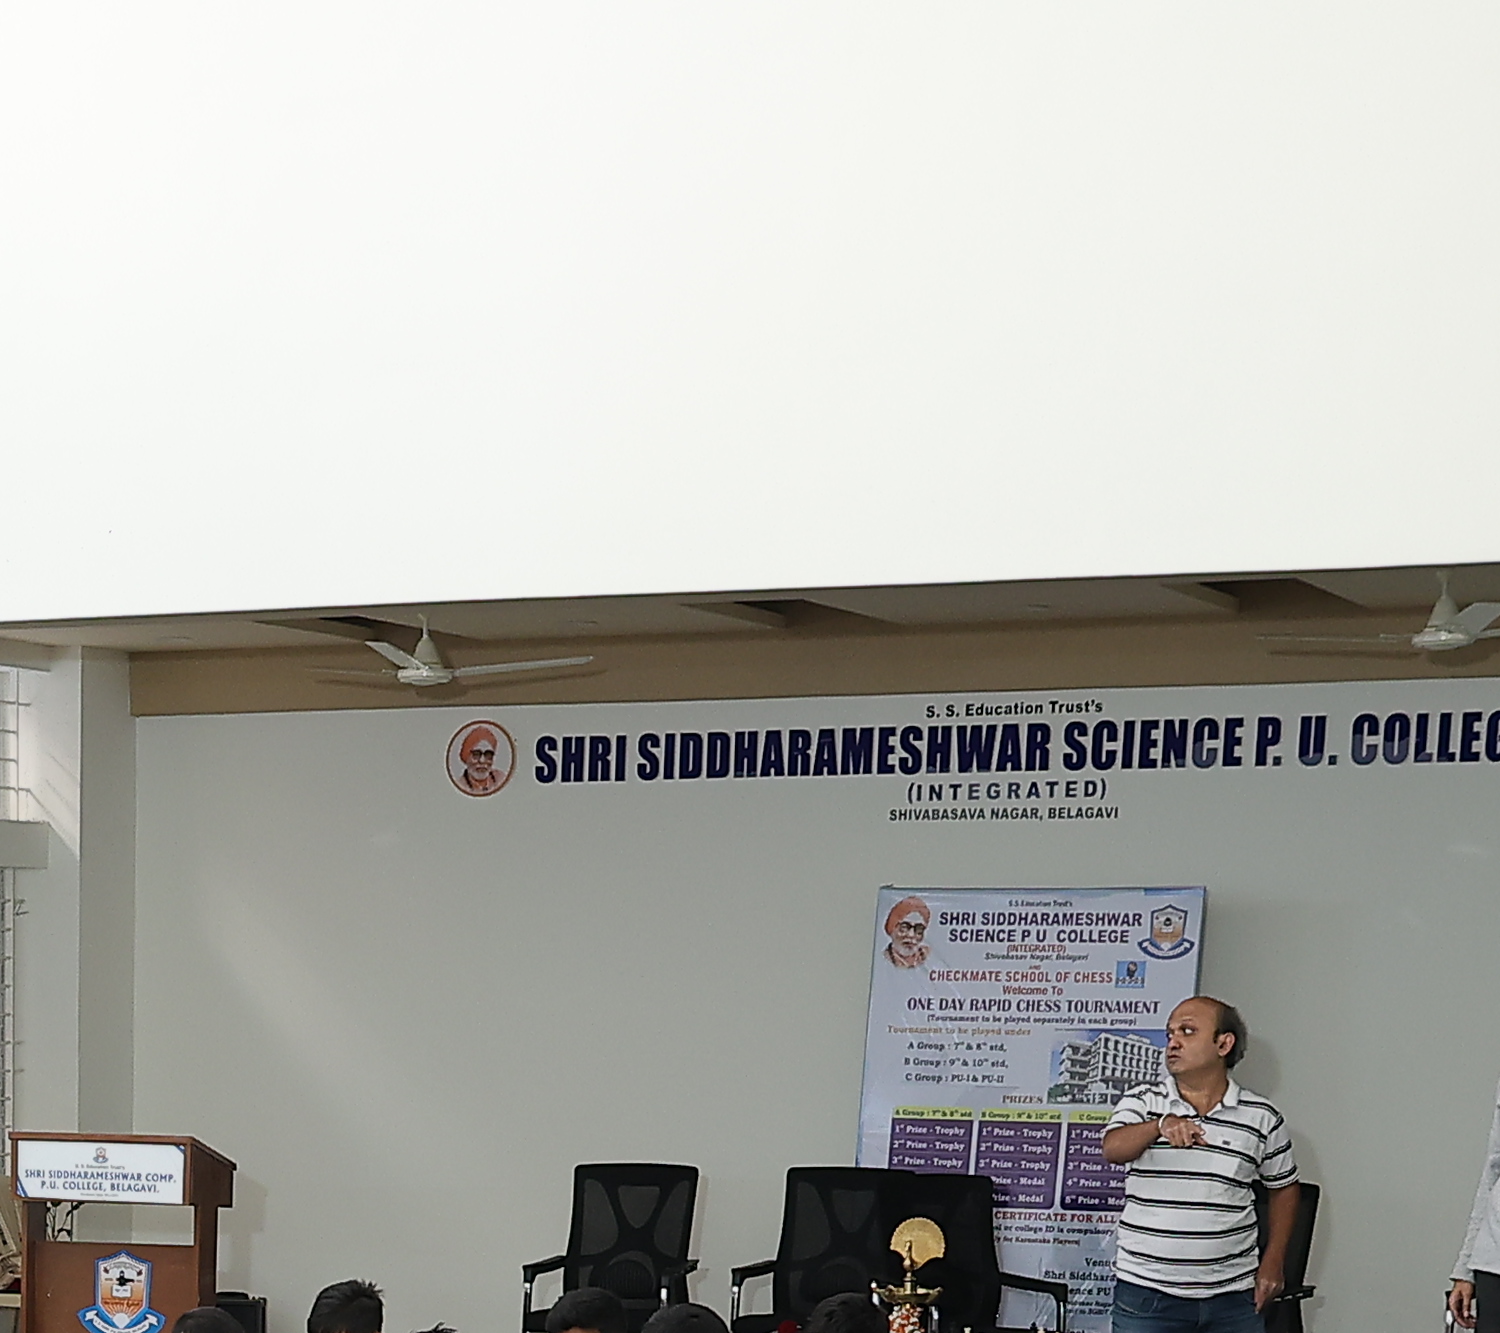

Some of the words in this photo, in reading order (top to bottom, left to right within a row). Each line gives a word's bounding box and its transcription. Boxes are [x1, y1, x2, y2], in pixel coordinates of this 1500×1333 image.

[926, 706, 941, 718] S.
[945, 705, 960, 717] S.
[965, 702, 1043, 716] Education
[1049, 700, 1103, 713] Trust's
[535, 735, 627, 783] SHRI
[637, 722, 1051, 782] SIDDHARAMESHWAR
[1062, 717, 1244, 771] SCIENCE
[1255, 715, 1283, 767] P.
[1299, 714, 1338, 766] U.
[889, 808, 986, 821] SHIVABASAVA
[990, 807, 1043, 821] NAGAR,
[1048, 806, 1119, 820] BELAGAVI
[939, 912, 976, 926] SHRI
[981, 912, 1143, 927] SIDDHARAMESHWAR
[949, 929, 1016, 942] SCIENCE
[1021, 930, 1031, 942] P
[1035, 930, 1047, 943] U
[1056, 930, 1130, 943] COLLEGE
[929, 970, 1001, 983] CHECKMATE
[1005, 971, 1051, 983] SCHOOL
[1055, 971, 1070, 983] OF
[1074, 972, 1113, 984] CHESS
[1002, 985, 1049, 996] Welcome
[1051, 986, 1064, 996] To
[907, 998, 937, 1011] ONE
[938, 998, 966, 1011] DAY
[970, 998, 1012, 1012] RAPID
[1016, 999, 1061, 1013] CHESS
[1065, 1000, 1161, 1015] TOURNAMENT
[917, 1042, 945, 1052] Group
[913, 1057, 941, 1068] Group
[905, 1073, 912, 1081] C
[914, 1073, 943, 1084] Group
[1002, 1094, 1043, 1104] PRIZES
[906, 1125, 927, 1134] Prize
[935, 1126, 965, 1136] Trophy
[994, 1127, 1014, 1136] Prize
[1023, 1128, 1054, 1138] Trophy
[906, 1140, 927, 1149] Prize
[935, 1141, 965, 1151] Trophy
[993, 1143, 1014, 1152] Prize
[1022, 1144, 1053, 1154] Trophy
[904, 1156, 925, 1165] Prize
[933, 1158, 963, 1168] Trophy
[991, 1160, 1012, 1168] Prize
[1021, 1161, 1051, 1171] Trophy
[1080, 1162, 1102, 1171] Prize
[25, 1169, 45, 1178] SHRI
[48, 1170, 142, 1182] SIDDHARAMESHWAR
[145, 1173, 177, 1183] COMP.
[1019, 1177, 1045, 1186] Medal
[40, 1181, 60, 1190] P.U.
[63, 1181, 107, 1192] COLLEGE,
[110, 1182, 160, 1194] BELAGAVI.
[1079, 1179, 1101, 1187] Prize
[992, 1193, 1010, 1201] rize
[1018, 1194, 1044, 1203] Medal
[1078, 1196, 1099, 1204] Prize
[994, 1211, 1067, 1222] CERTIFICATE
[1071, 1213, 1093, 1223] FOR
[1096, 1214, 1117, 1224] ALL
[1043, 1270, 1066, 1280] Shri
